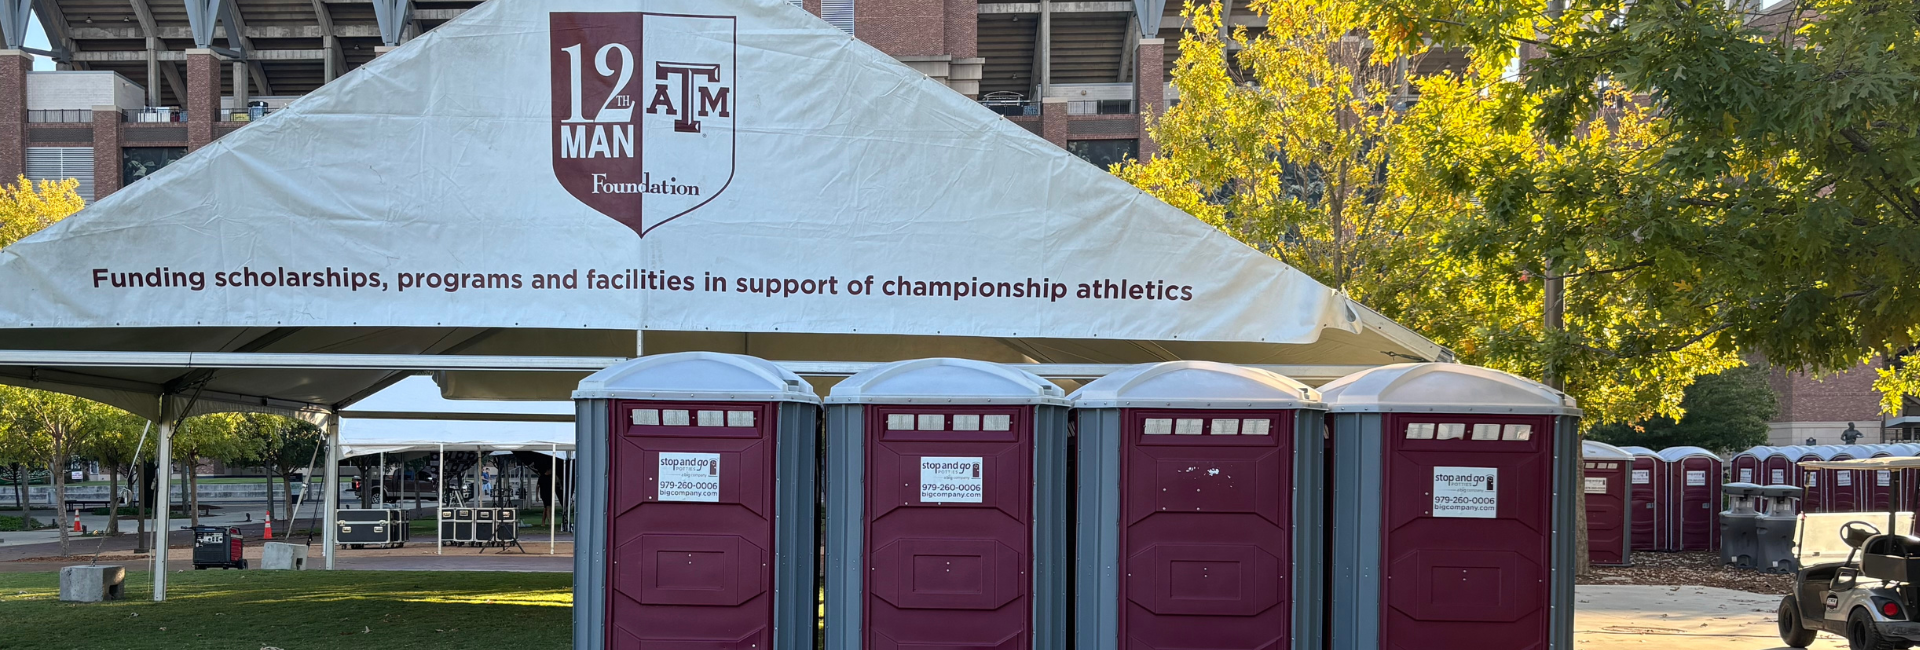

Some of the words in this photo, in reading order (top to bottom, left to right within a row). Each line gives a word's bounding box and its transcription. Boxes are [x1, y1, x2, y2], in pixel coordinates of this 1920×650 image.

[561, 124, 634, 159] MAN
[592, 172, 700, 196] Foundation
[92, 267, 206, 292] Funding
[214, 267, 388, 292] scholarships,
[397, 272, 523, 293] programs
[531, 269, 578, 290] and
[586, 269, 695, 292] facilities
[704, 272, 727, 293] in
[735, 276, 839, 298] support
[846, 275, 875, 296] of
[881, 276, 1068, 303] championship
[1076, 279, 1193, 302] athletics
[660, 458, 679, 471] stop
[680, 458, 697, 467] and
[697, 459, 709, 471] go
[922, 462, 941, 474] stop
[941, 461, 959, 470] and
[959, 463, 971, 474] go
[660, 481, 718, 490] 979-260-0006
[1435, 474, 1455, 486] stop
[1455, 473, 1472, 482] and
[1473, 475, 1485, 487] go
[1435, 496, 1495, 504] 979-260-0006
